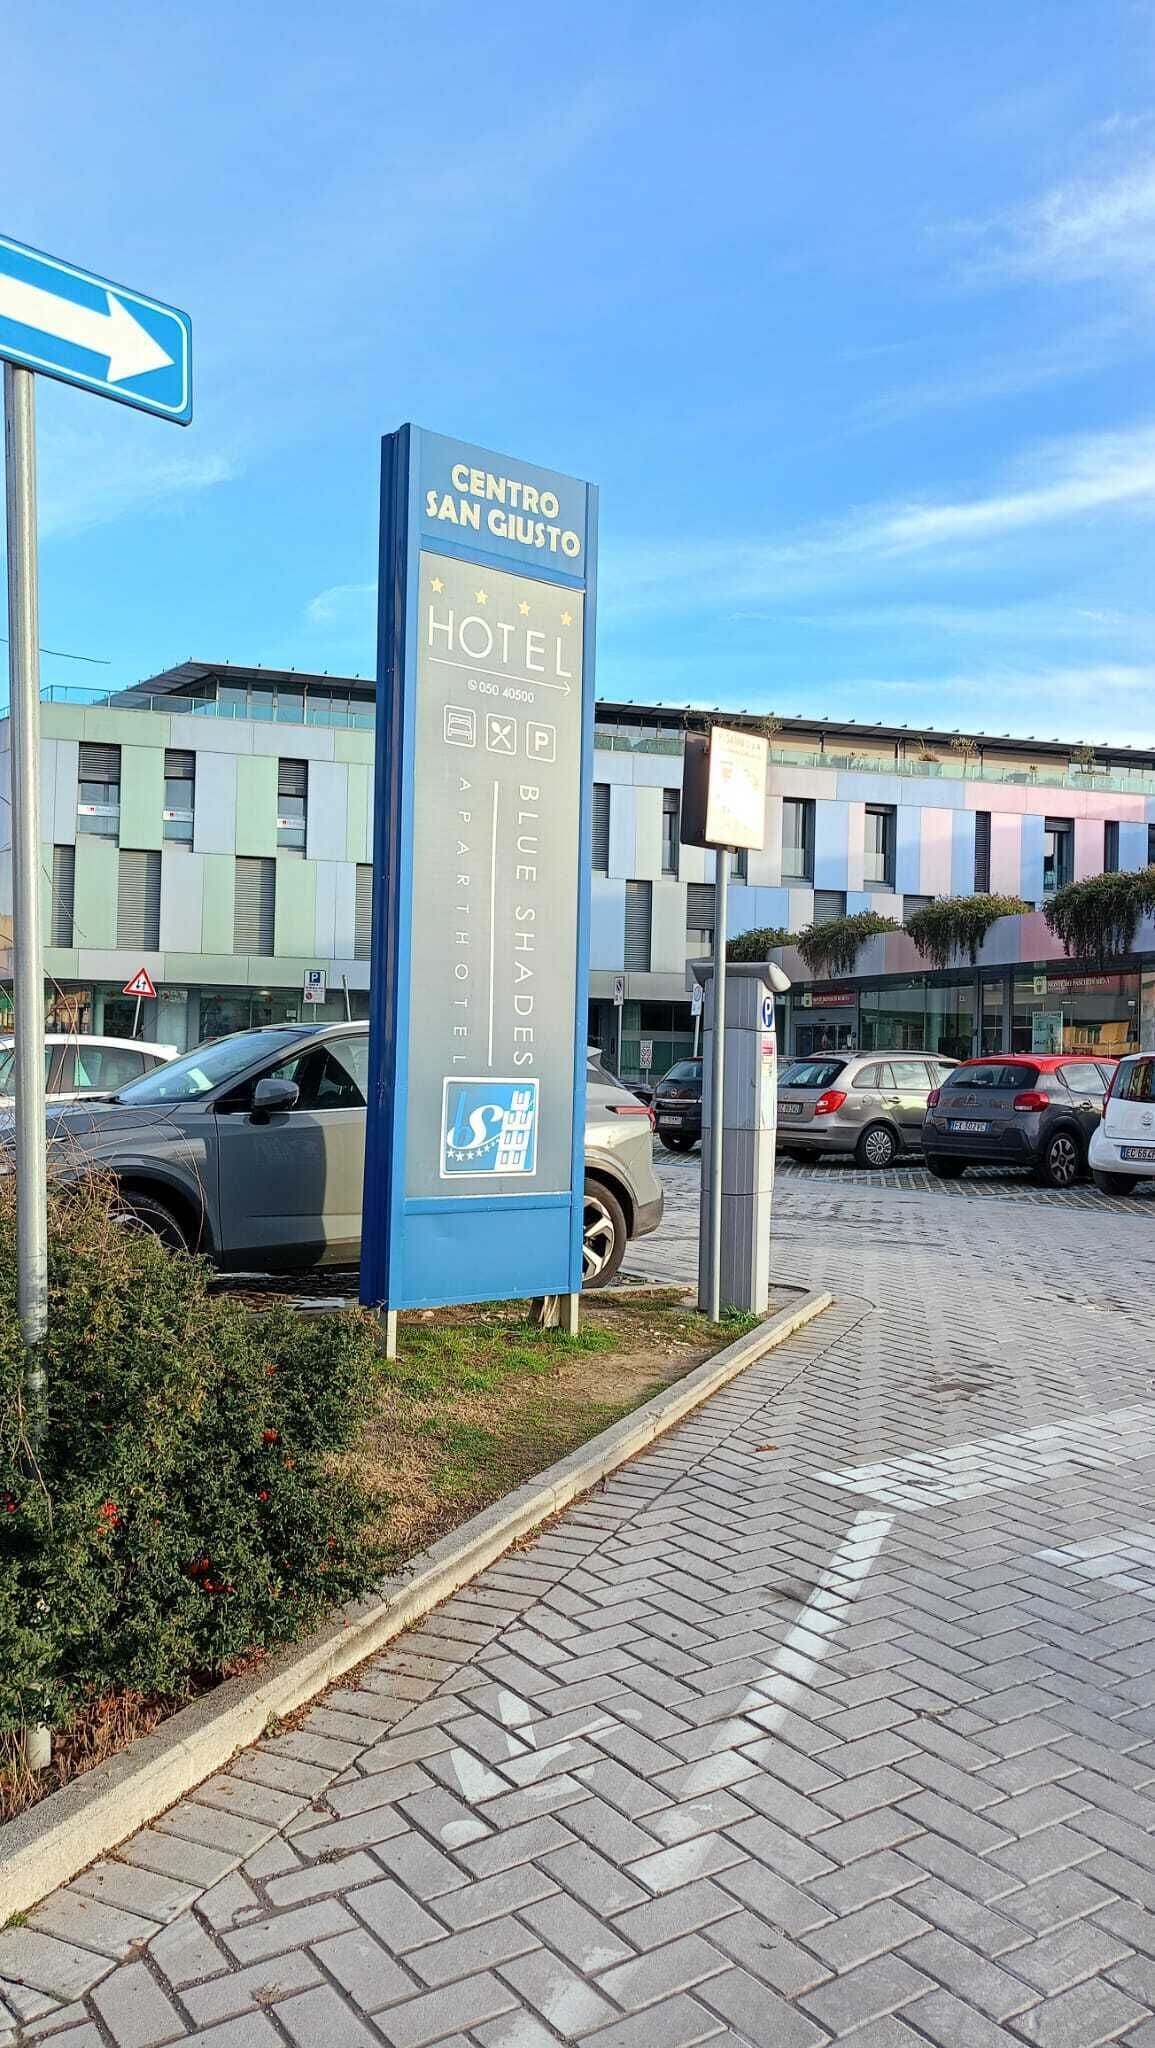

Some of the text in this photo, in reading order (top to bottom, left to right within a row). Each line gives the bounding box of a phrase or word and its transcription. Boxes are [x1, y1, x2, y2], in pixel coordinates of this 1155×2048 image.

[425, 489, 582, 558] SAN GIUSTO
[451, 463, 560, 519] CENTRO
[427, 604, 573, 679] HOTEL
[478, 681, 535, 703] 050 40500
[515, 782, 540, 882] BLUE
[452, 776, 474, 1065] APARTHOTEL
[513, 905, 537, 1067] SHADES
